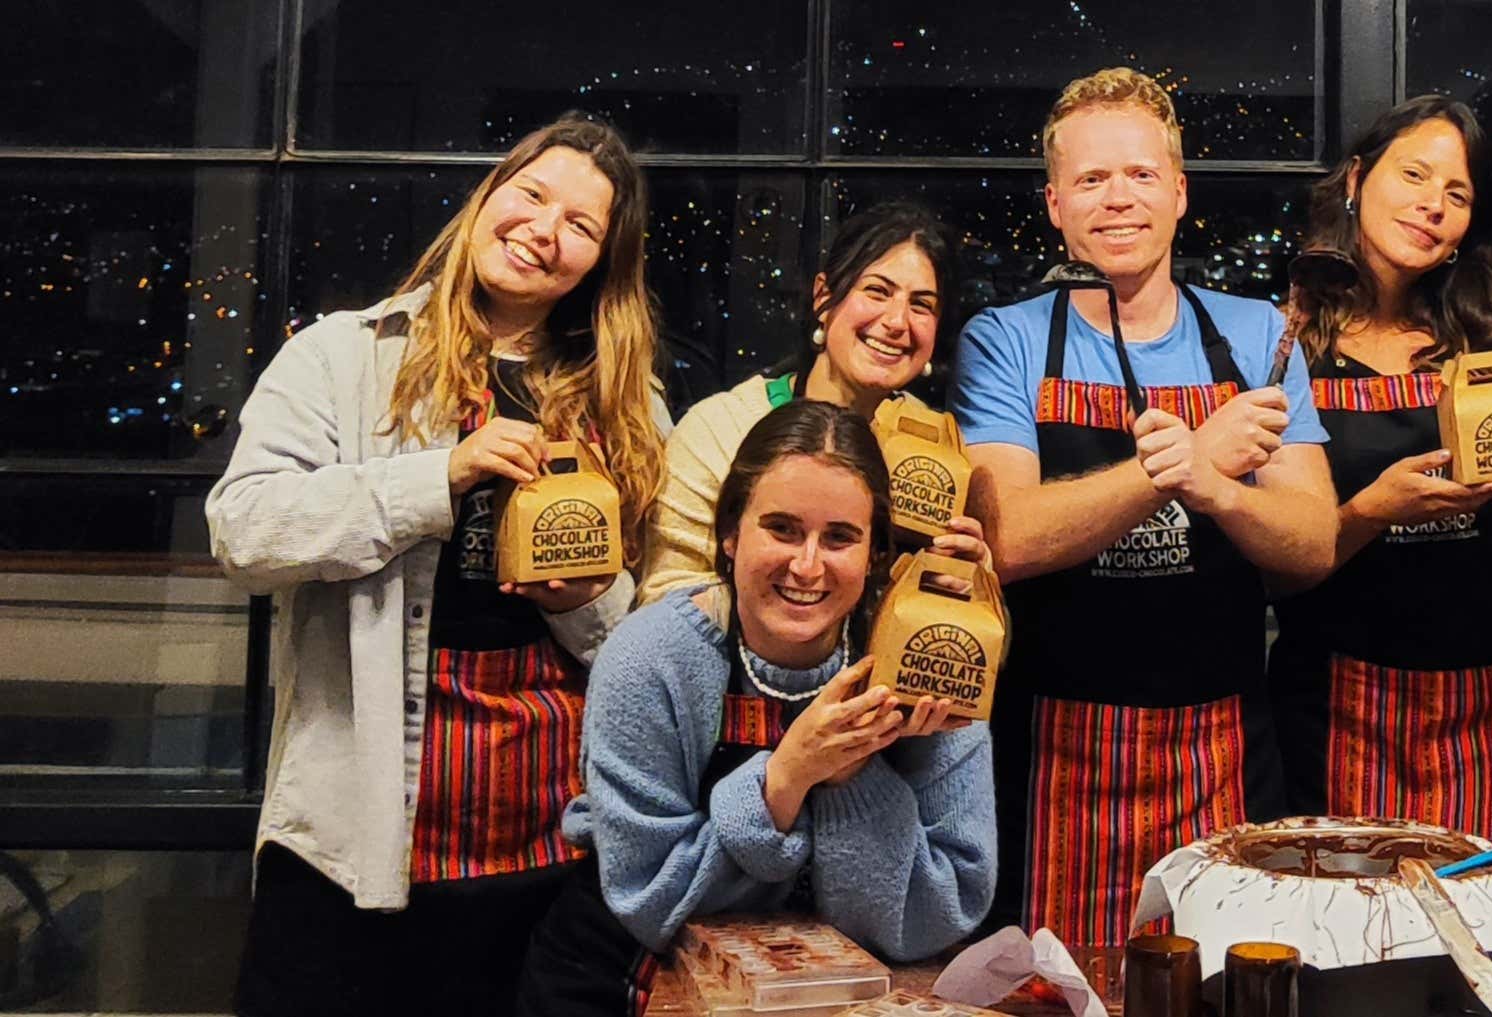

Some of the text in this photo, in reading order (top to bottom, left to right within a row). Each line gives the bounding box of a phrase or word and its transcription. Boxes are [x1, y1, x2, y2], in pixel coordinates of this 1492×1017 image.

[897, 457, 954, 491] ORIGINAL
[890, 478, 955, 510] CHOCOLATE
[532, 528, 609, 548] CHOCOLATE
[1113, 528, 1188, 550] OCOLATE
[532, 544, 610, 564] WORKSHOP
[1097, 547, 1190, 568] WORKSHOP
[909, 625, 982, 665] ORIGINAL
[900, 652, 986, 685] CHOCOLATE
[896, 670, 982, 701] WORKSHOP
